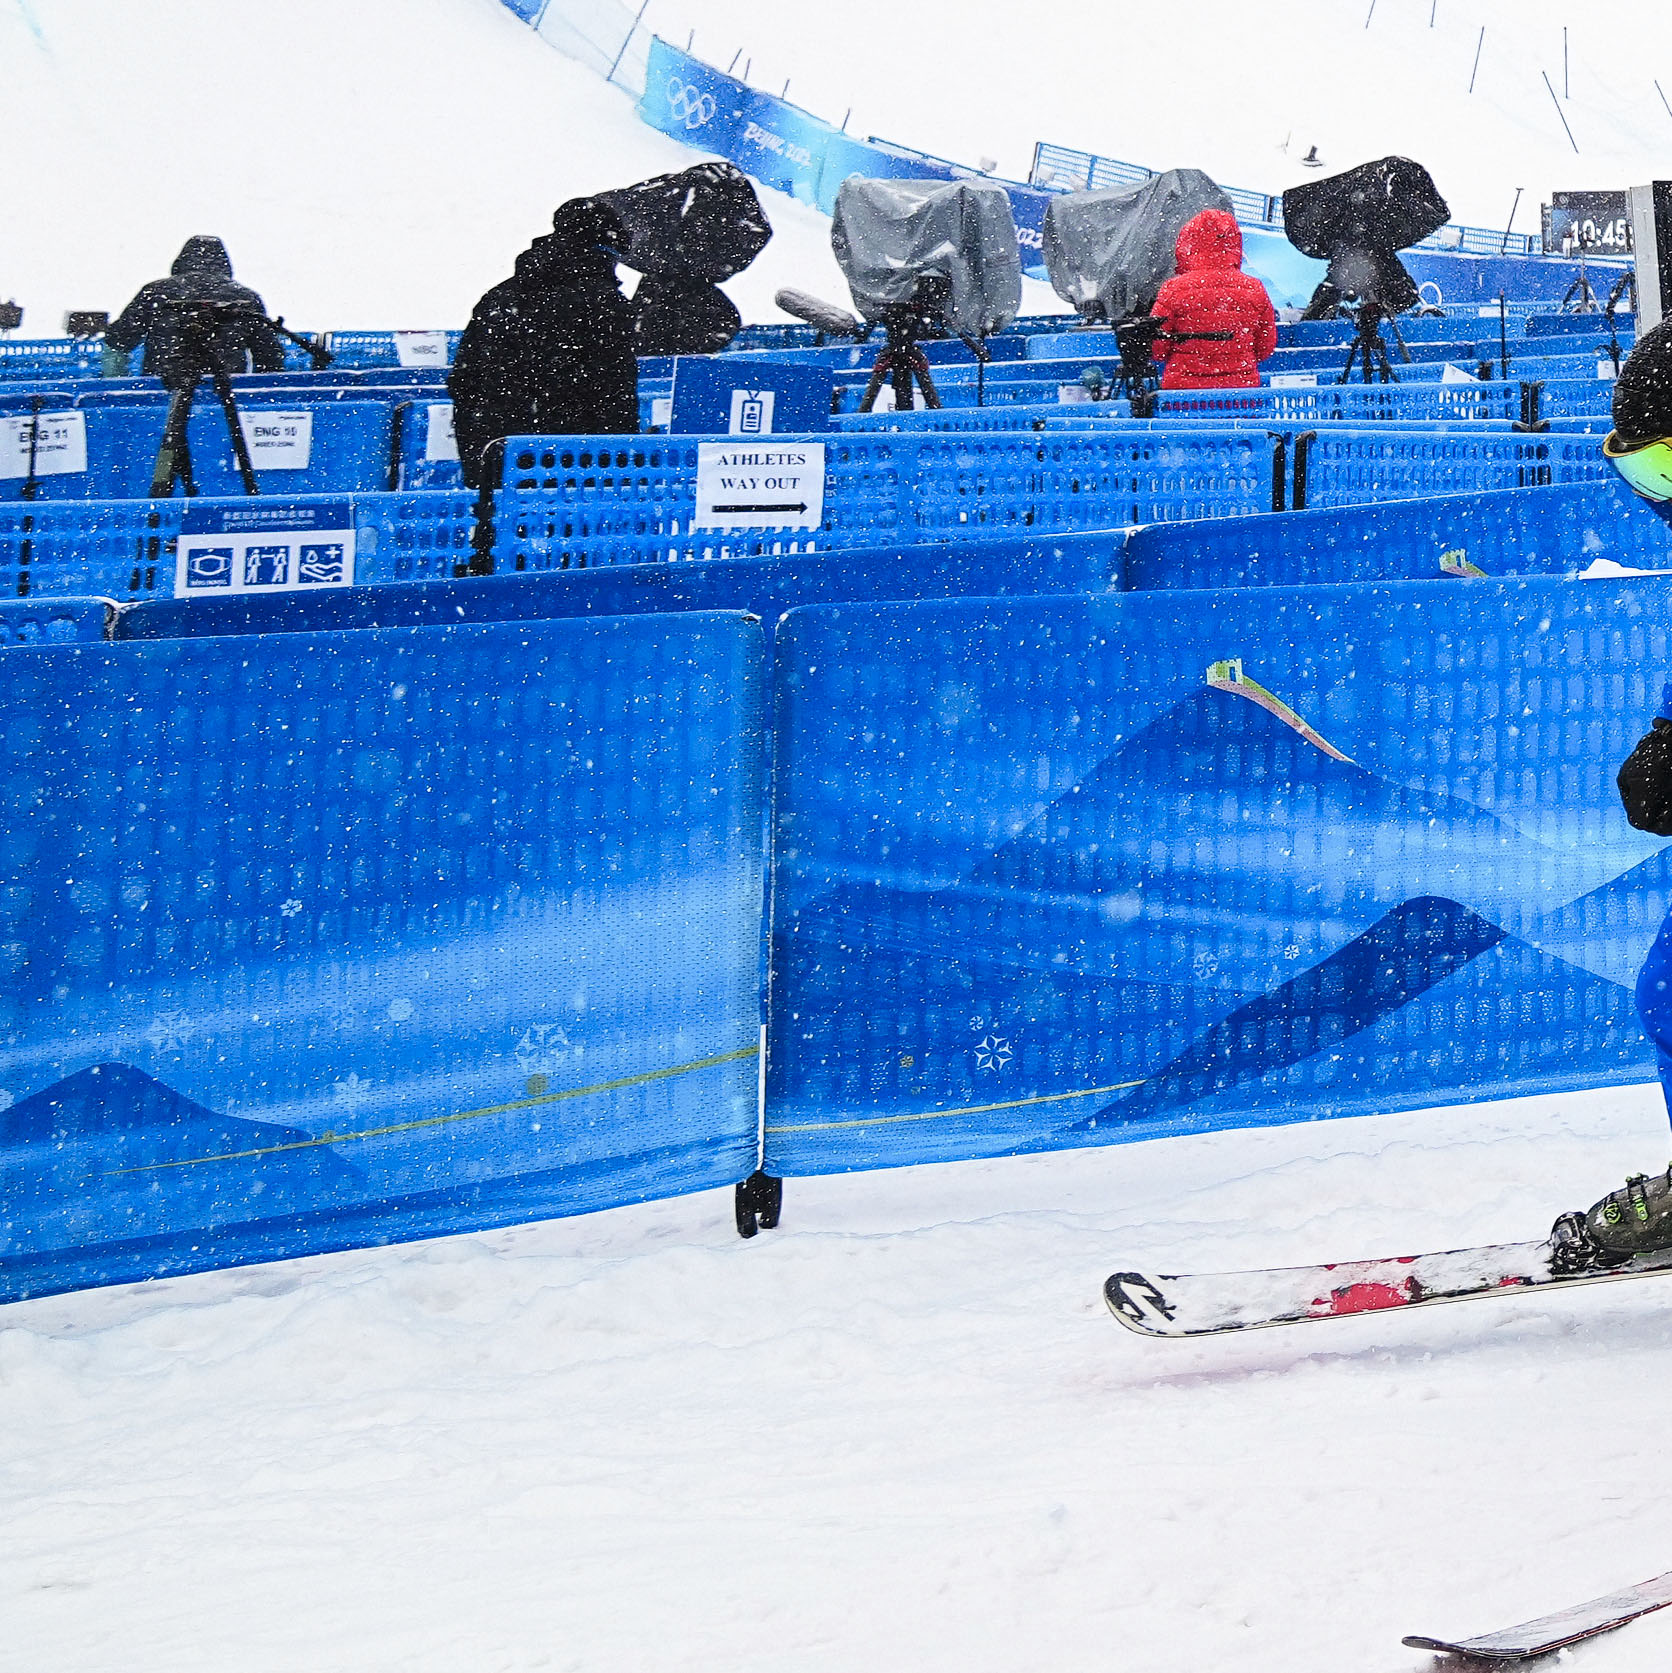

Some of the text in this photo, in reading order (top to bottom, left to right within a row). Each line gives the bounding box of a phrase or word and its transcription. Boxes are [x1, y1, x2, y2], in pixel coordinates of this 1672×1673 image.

[254, 427, 280, 437] ENG
[717, 454, 806, 465] ATHLETES
[720, 477, 801, 490] WAY OUT
